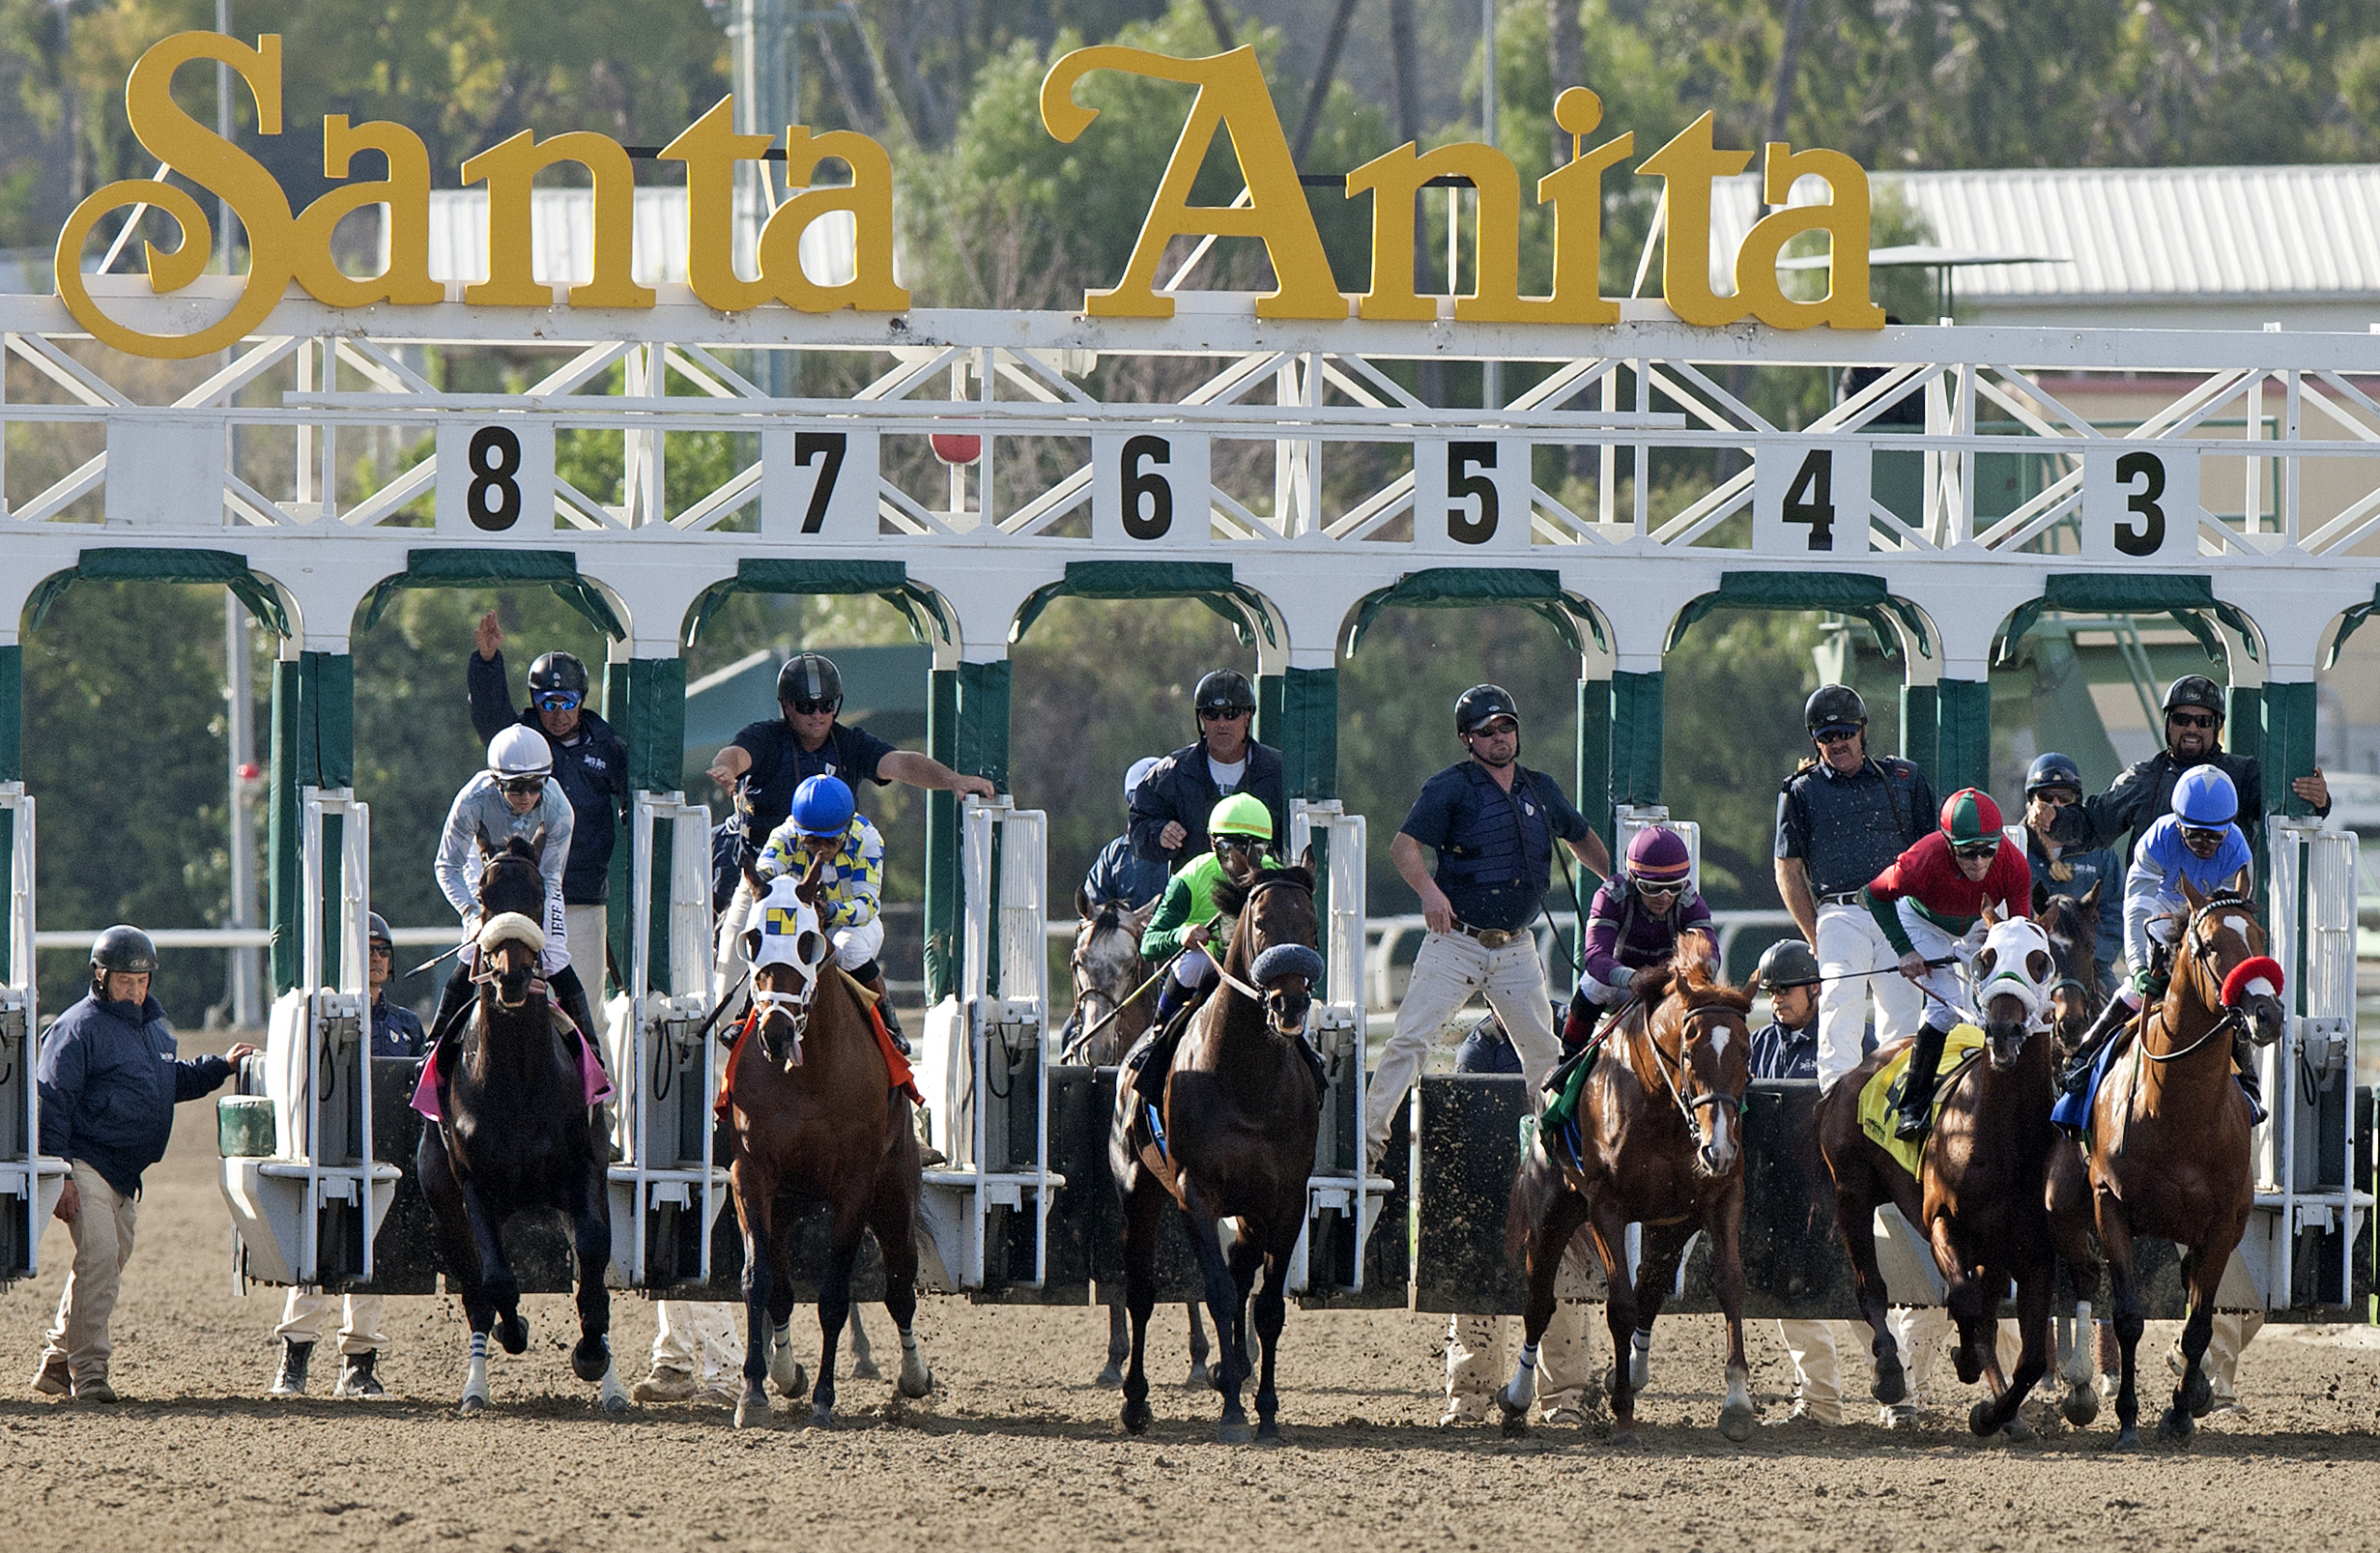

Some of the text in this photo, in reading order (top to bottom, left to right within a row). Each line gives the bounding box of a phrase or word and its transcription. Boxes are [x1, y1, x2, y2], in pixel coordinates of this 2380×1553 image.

[55, 30, 1886, 359] Santa Anita
[467, 425, 522, 532] 8
[794, 431, 847, 534] 7
[1120, 434, 1173, 541] 6
[1448, 441, 1500, 545] 5
[1782, 448, 1835, 551] 4
[2114, 451, 2165, 558] 3
[551, 905, 565, 936] JEFF
